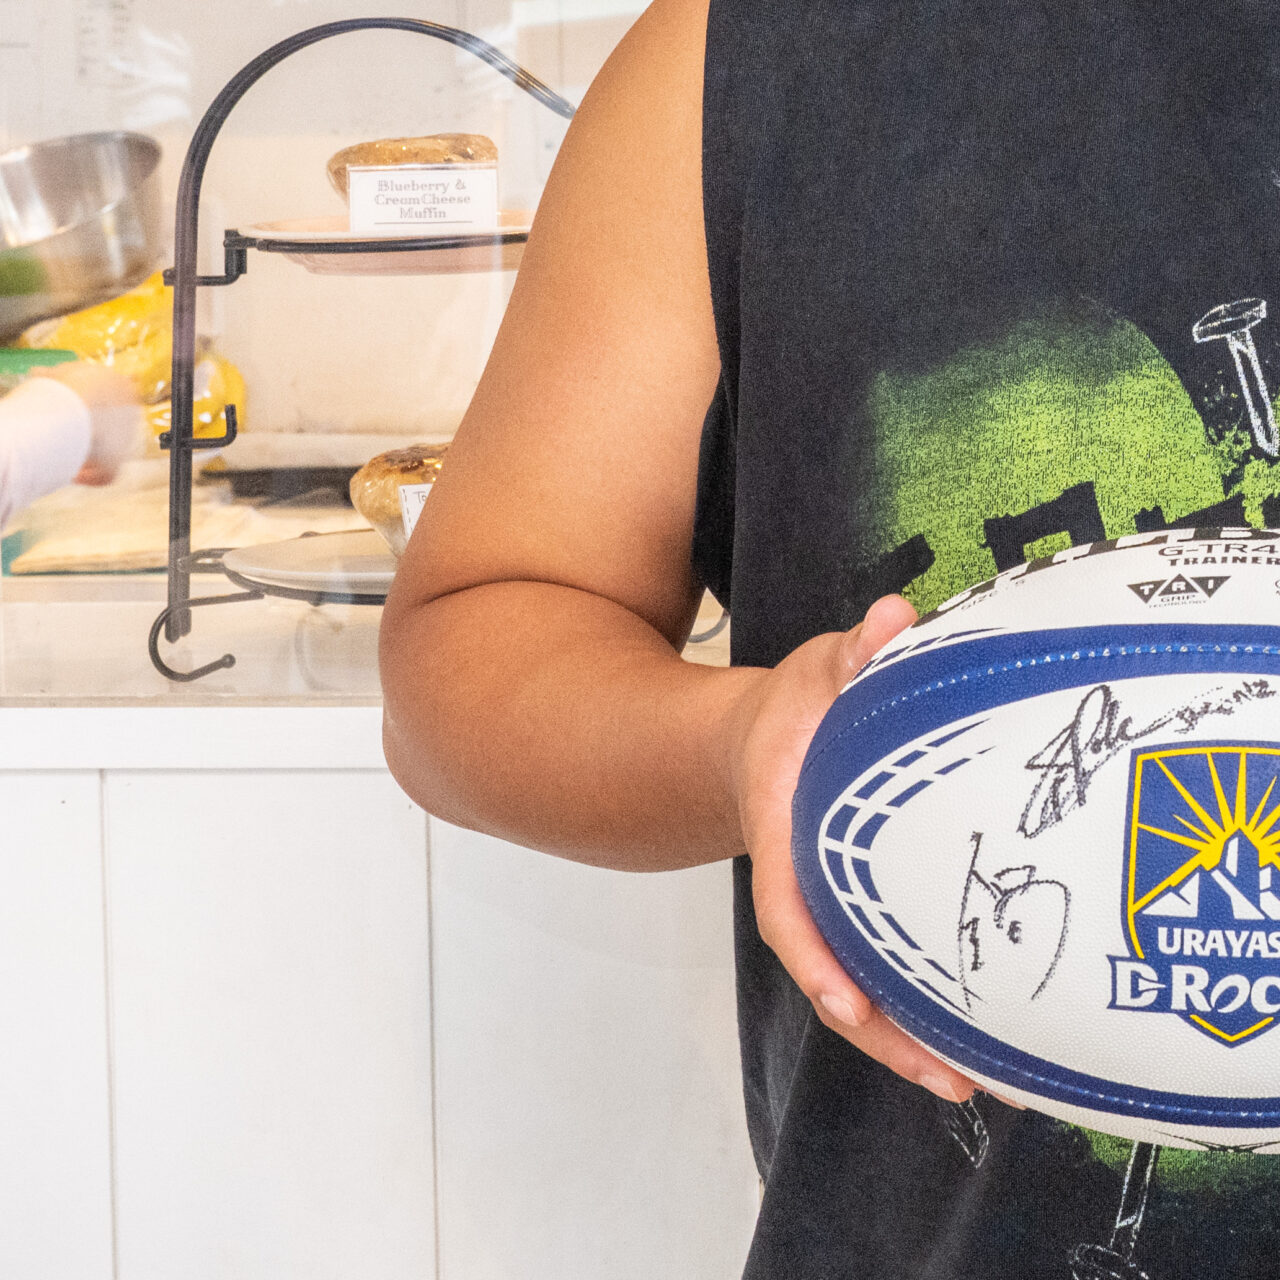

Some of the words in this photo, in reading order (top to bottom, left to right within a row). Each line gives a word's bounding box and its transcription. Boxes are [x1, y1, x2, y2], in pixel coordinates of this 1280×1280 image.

[377, 179, 450, 194] Blueberry
[455, 177, 467, 190] &
[399, 206, 447, 220] Muffin
[1159, 595, 1197, 603] GRIP
